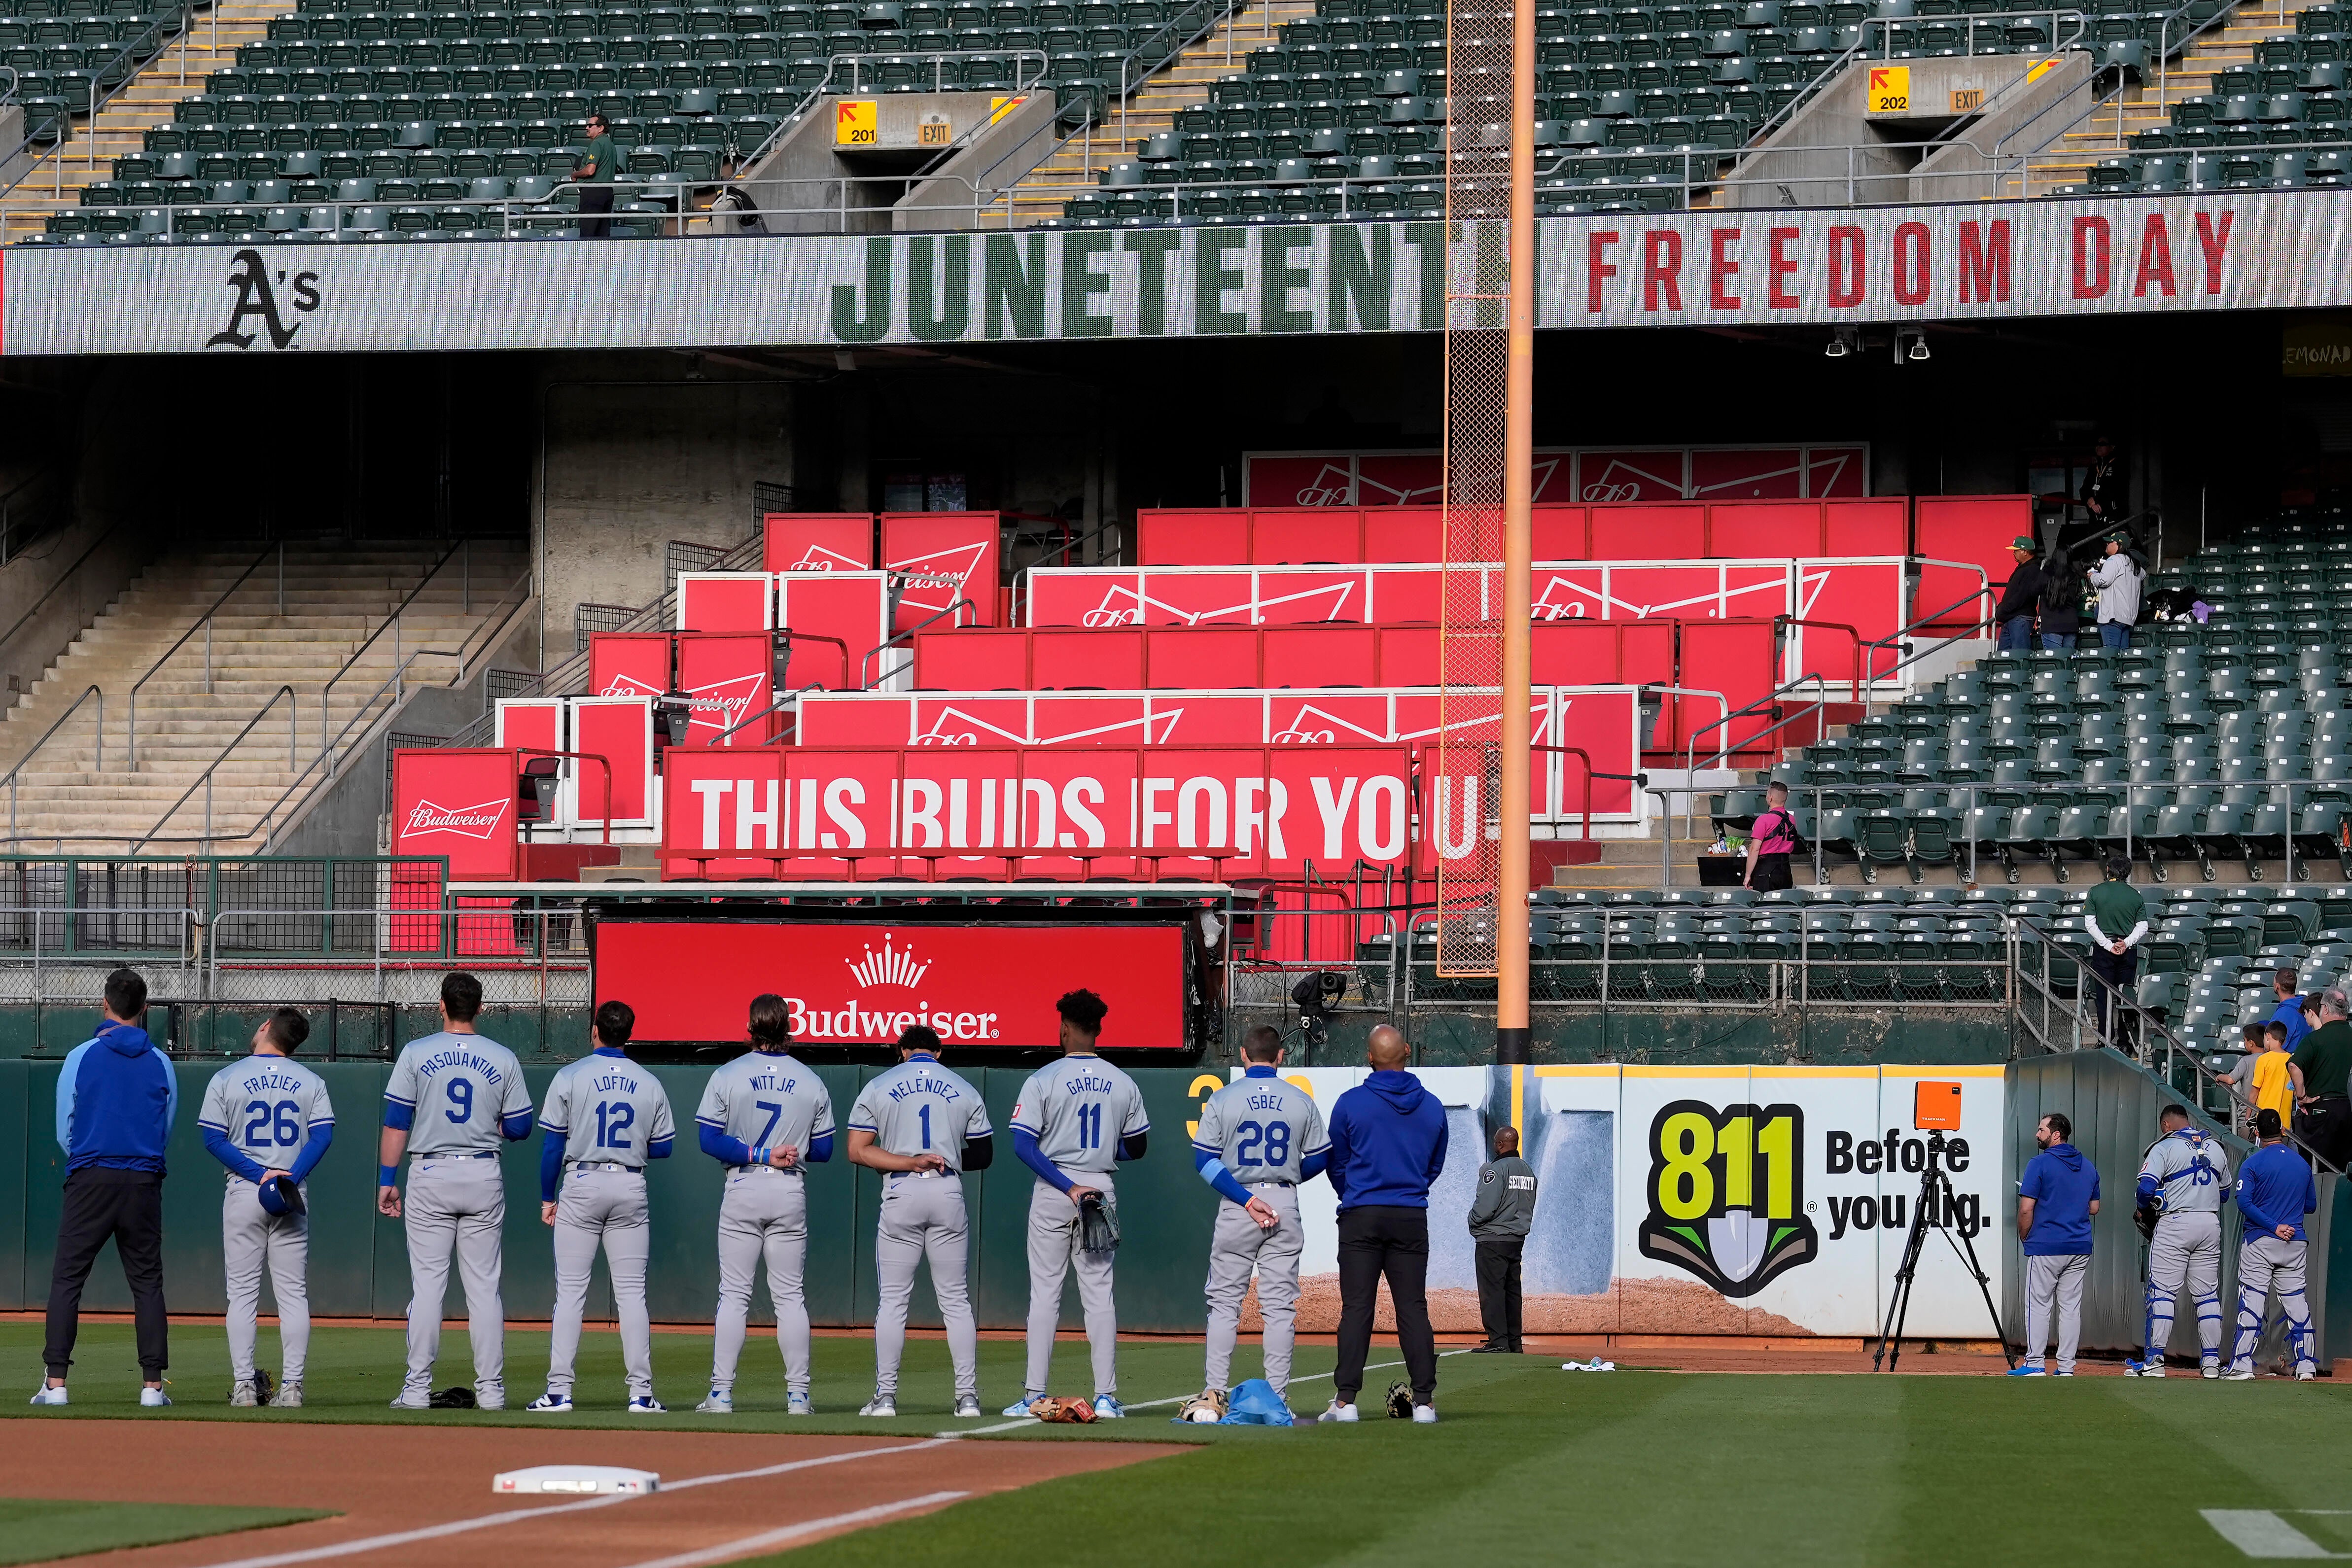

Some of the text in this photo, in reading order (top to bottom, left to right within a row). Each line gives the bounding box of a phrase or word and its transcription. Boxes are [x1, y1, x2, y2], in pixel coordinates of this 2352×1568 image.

[1880, 97, 1907, 109] 202
[1956, 90, 1979, 109] EXIT
[851, 130, 875, 142] 201
[923, 125, 947, 143] EXIT
[1589, 220, 2011, 313] FREEDOM
[2072, 210, 2234, 299] DAY
[206, 249, 321, 349] A's
[2282, 345, 2351, 366] EMONAD
[410, 808, 498, 828] Budweiser
[691, 777, 867, 860] THIS
[890, 777, 1106, 860] BUDS
[1130, 776, 1288, 860] FOR
[783, 998, 997, 1039] Budweiser
[244, 1075, 302, 1095] FRAZIER
[421, 1051, 502, 1085] PASQUANTINO
[445, 1078, 473, 1124] 9
[594, 1076, 637, 1095] LOFTIN
[749, 1076, 796, 1095] WITT JR.
[888, 1079, 960, 1104] MELENDEZ
[1066, 1077, 1113, 1095] GARCIA
[1247, 1095, 1283, 1112] ISBEL
[246, 1100, 300, 1147] 26
[596, 1101, 635, 1149] 12
[755, 1101, 782, 1148] 7
[918, 1104, 931, 1150] 1
[1078, 1103, 1101, 1149] 11
[1237, 1121, 1291, 1167] 28
[1827, 1128, 1970, 1174] Befoe
[1509, 1175, 1535, 1190] SECURITY
[1659, 1112, 1792, 1220] 811
[2191, 1156, 2212, 1186] 13
[1827, 1196, 1906, 1240] you
